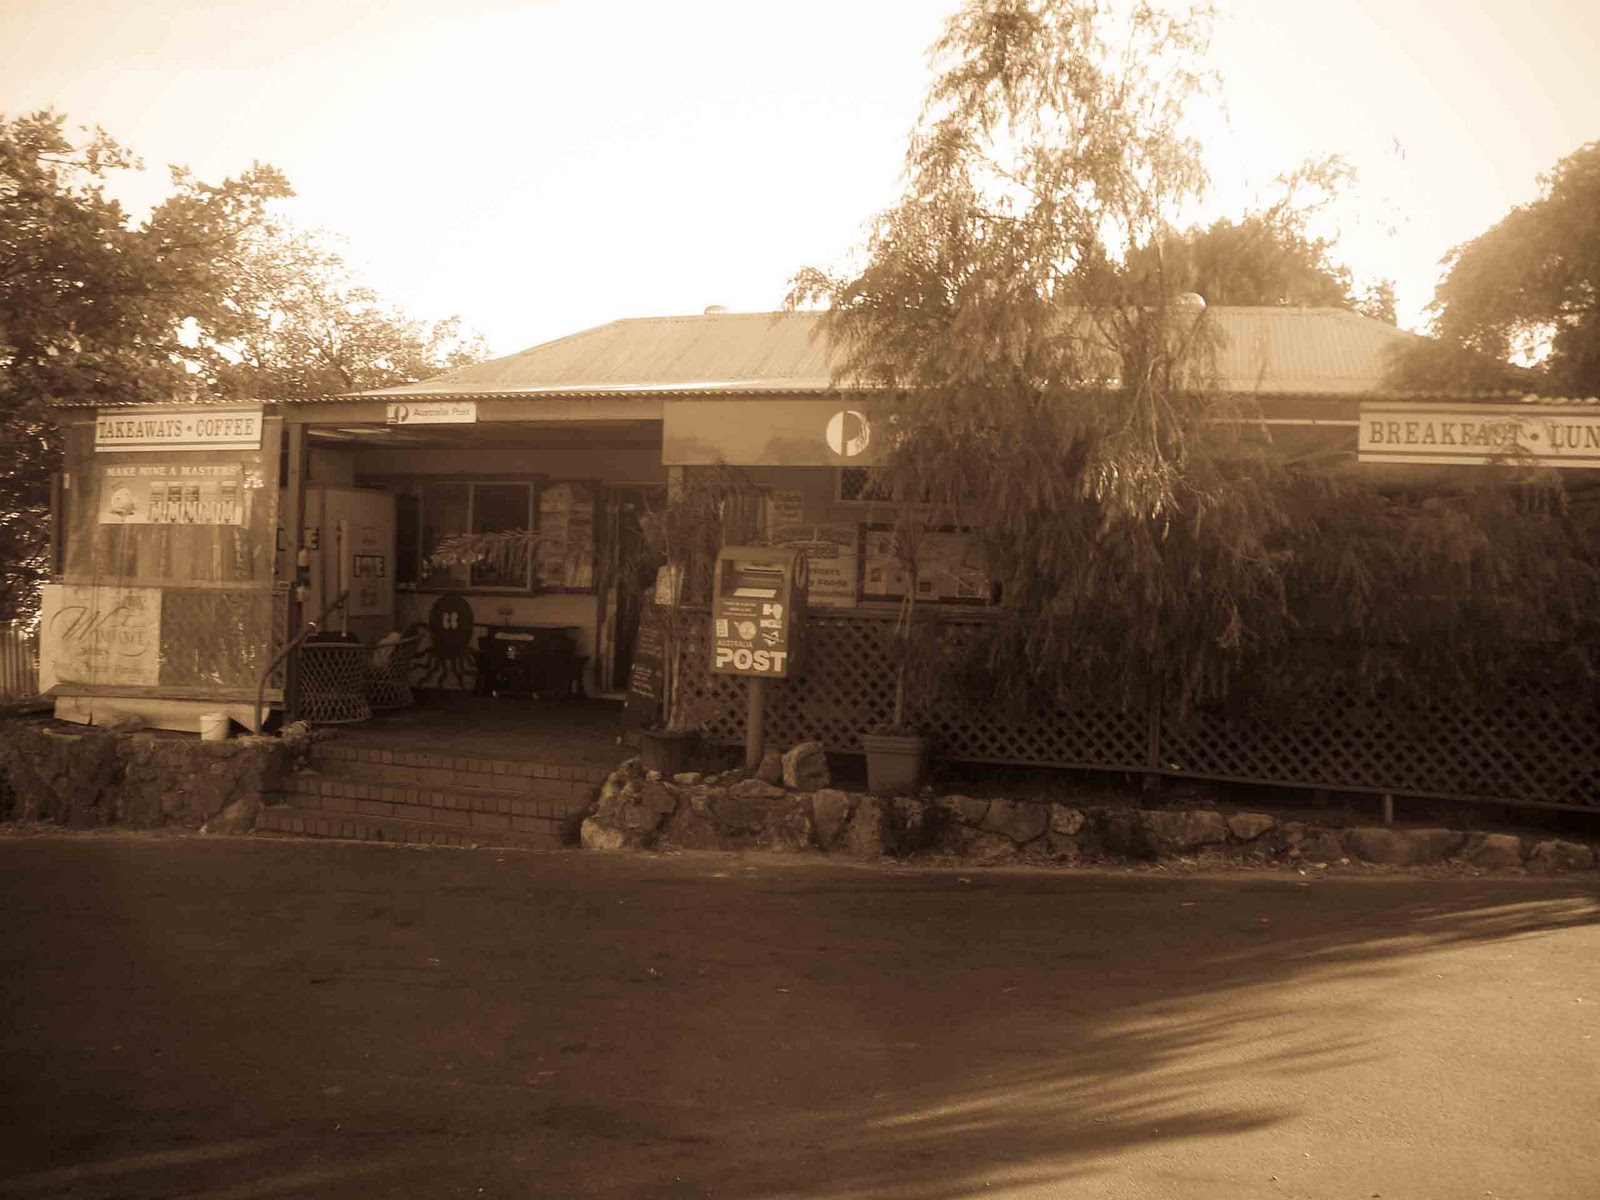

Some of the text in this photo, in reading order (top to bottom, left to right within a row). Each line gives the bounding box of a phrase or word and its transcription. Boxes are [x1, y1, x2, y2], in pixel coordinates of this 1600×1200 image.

[98, 418, 253, 439] TAKEAWAYS COFFEE
[1369, 421, 1523, 447] BREAKFAST
[106, 466, 136, 477] MAKE
[138, 465, 166, 476] MINE
[168, 466, 177, 475] A
[716, 648, 787, 672] POST
